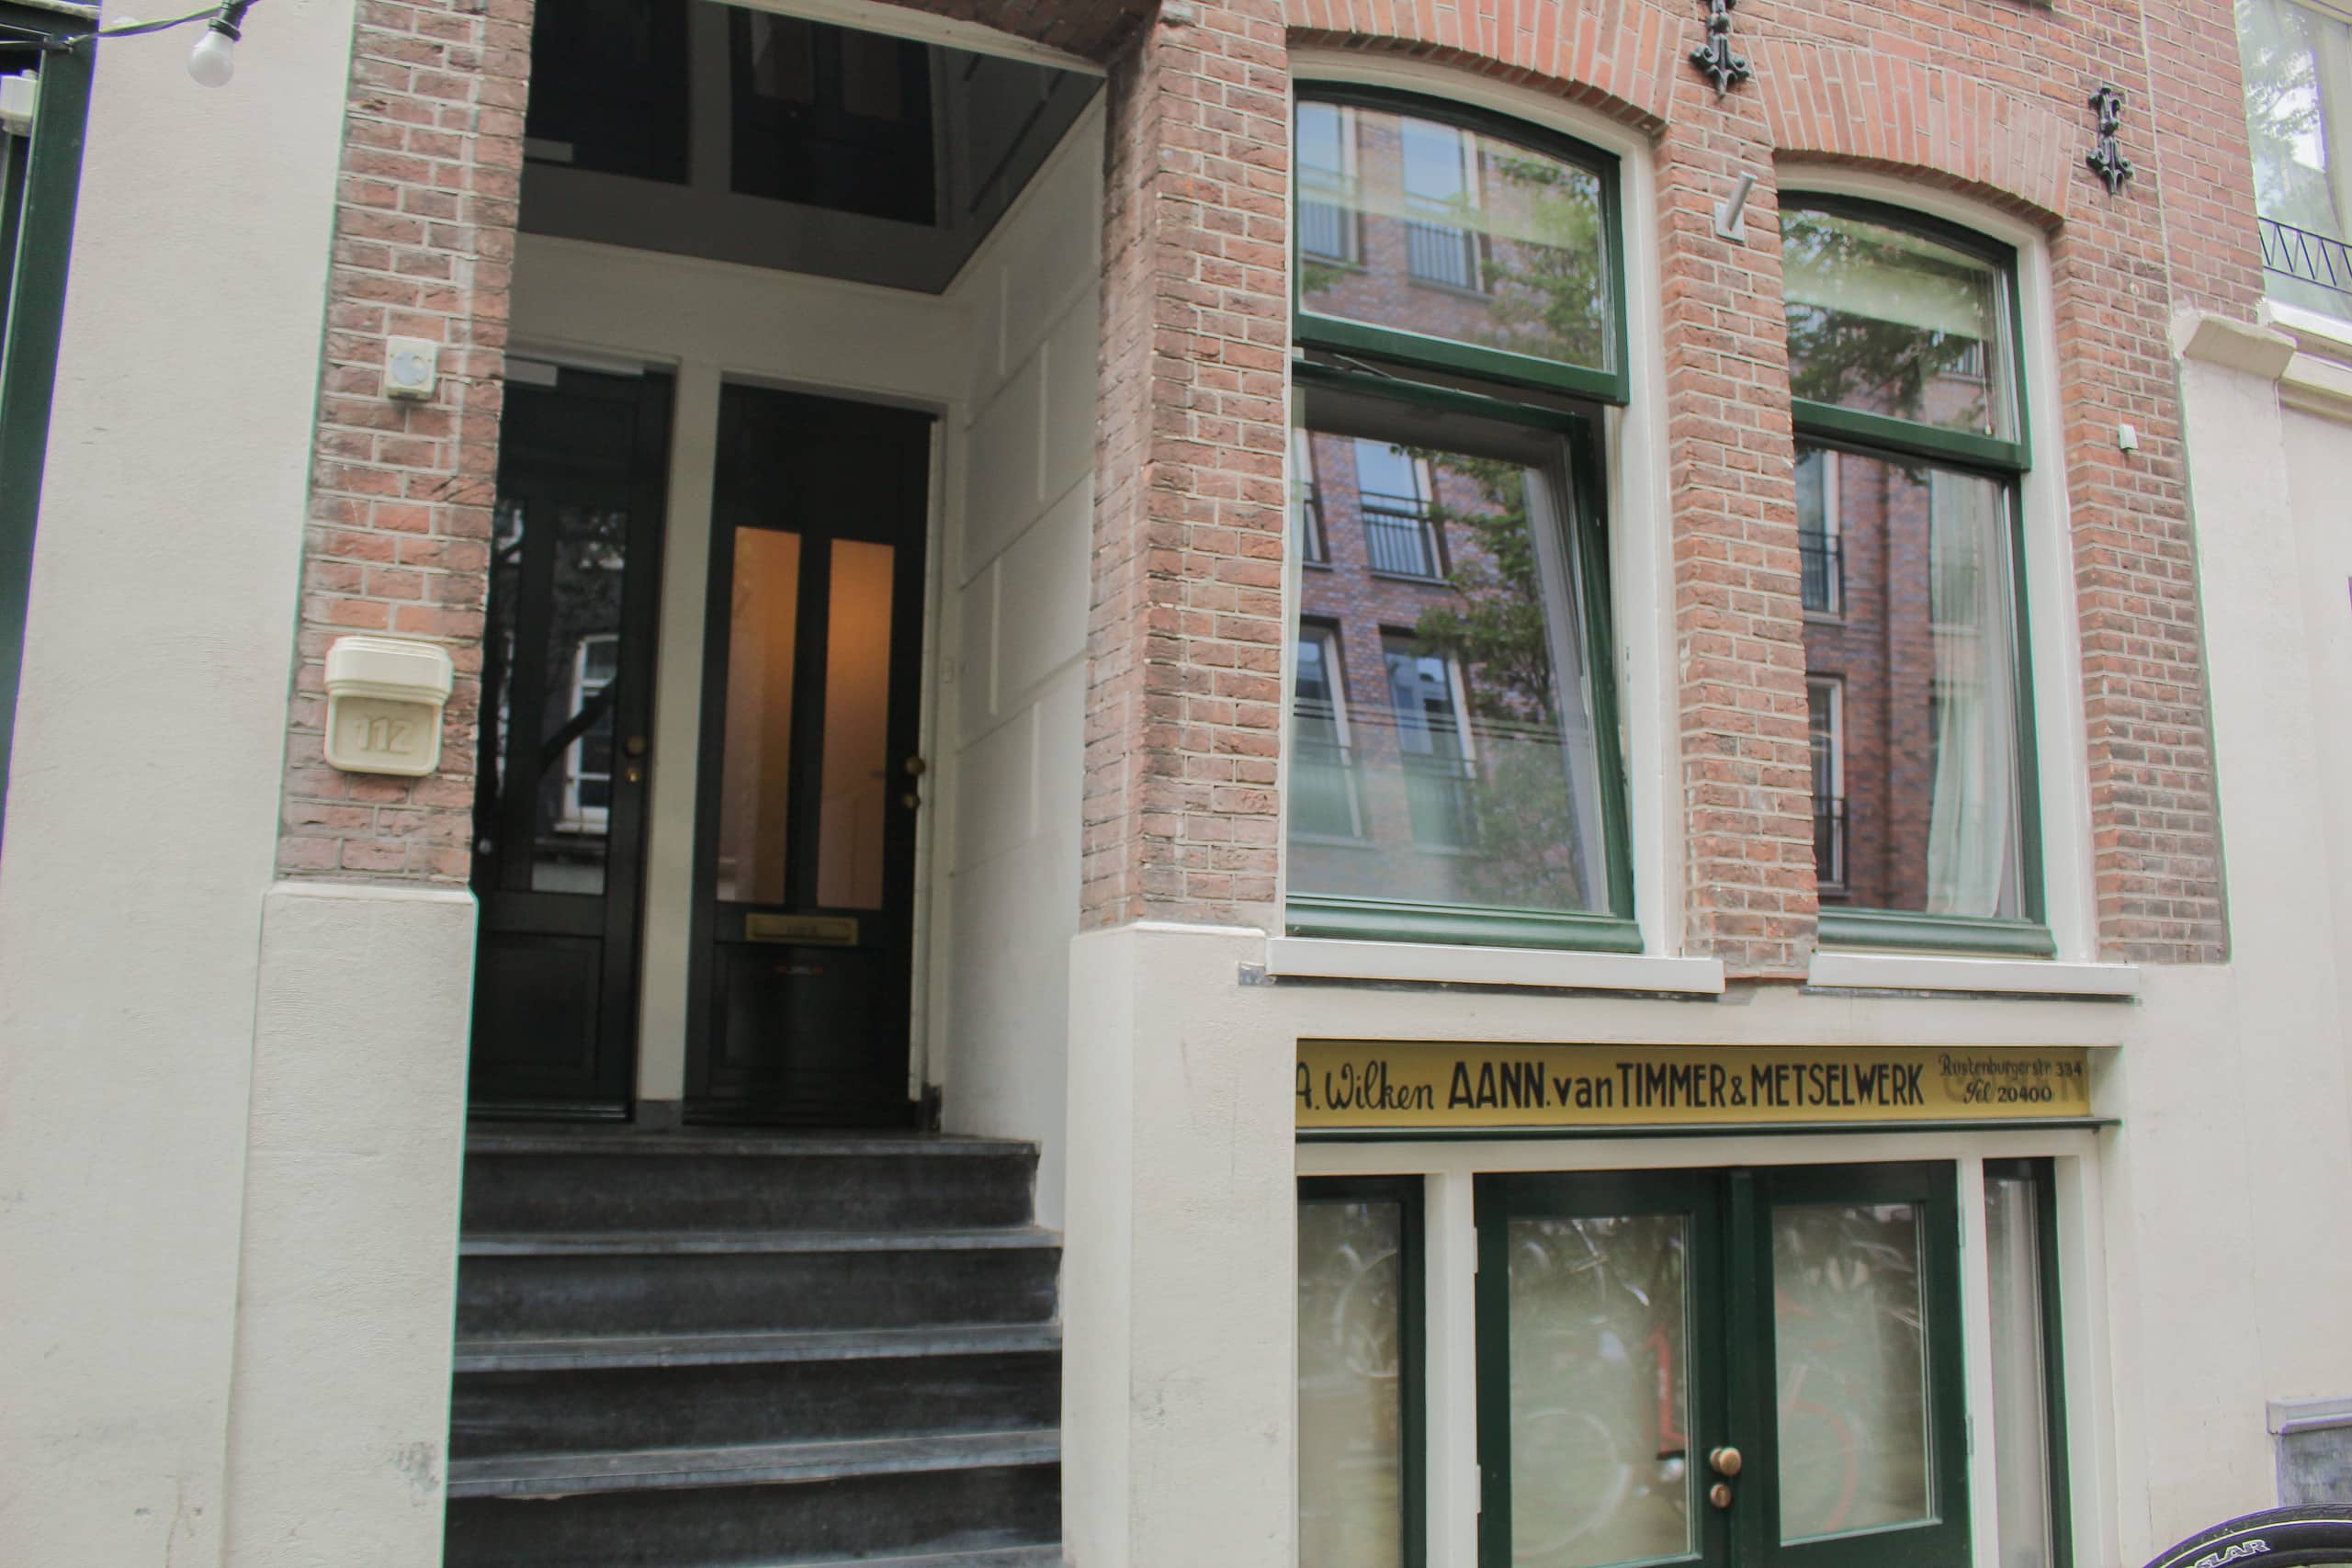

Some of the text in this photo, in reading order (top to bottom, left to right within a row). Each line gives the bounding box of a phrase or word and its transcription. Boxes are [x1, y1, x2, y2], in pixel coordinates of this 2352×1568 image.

[354, 714, 413, 755] 112
[1325, 1060, 1434, 1111] Wilken
[1997, 1086, 2053, 1103] 20400
